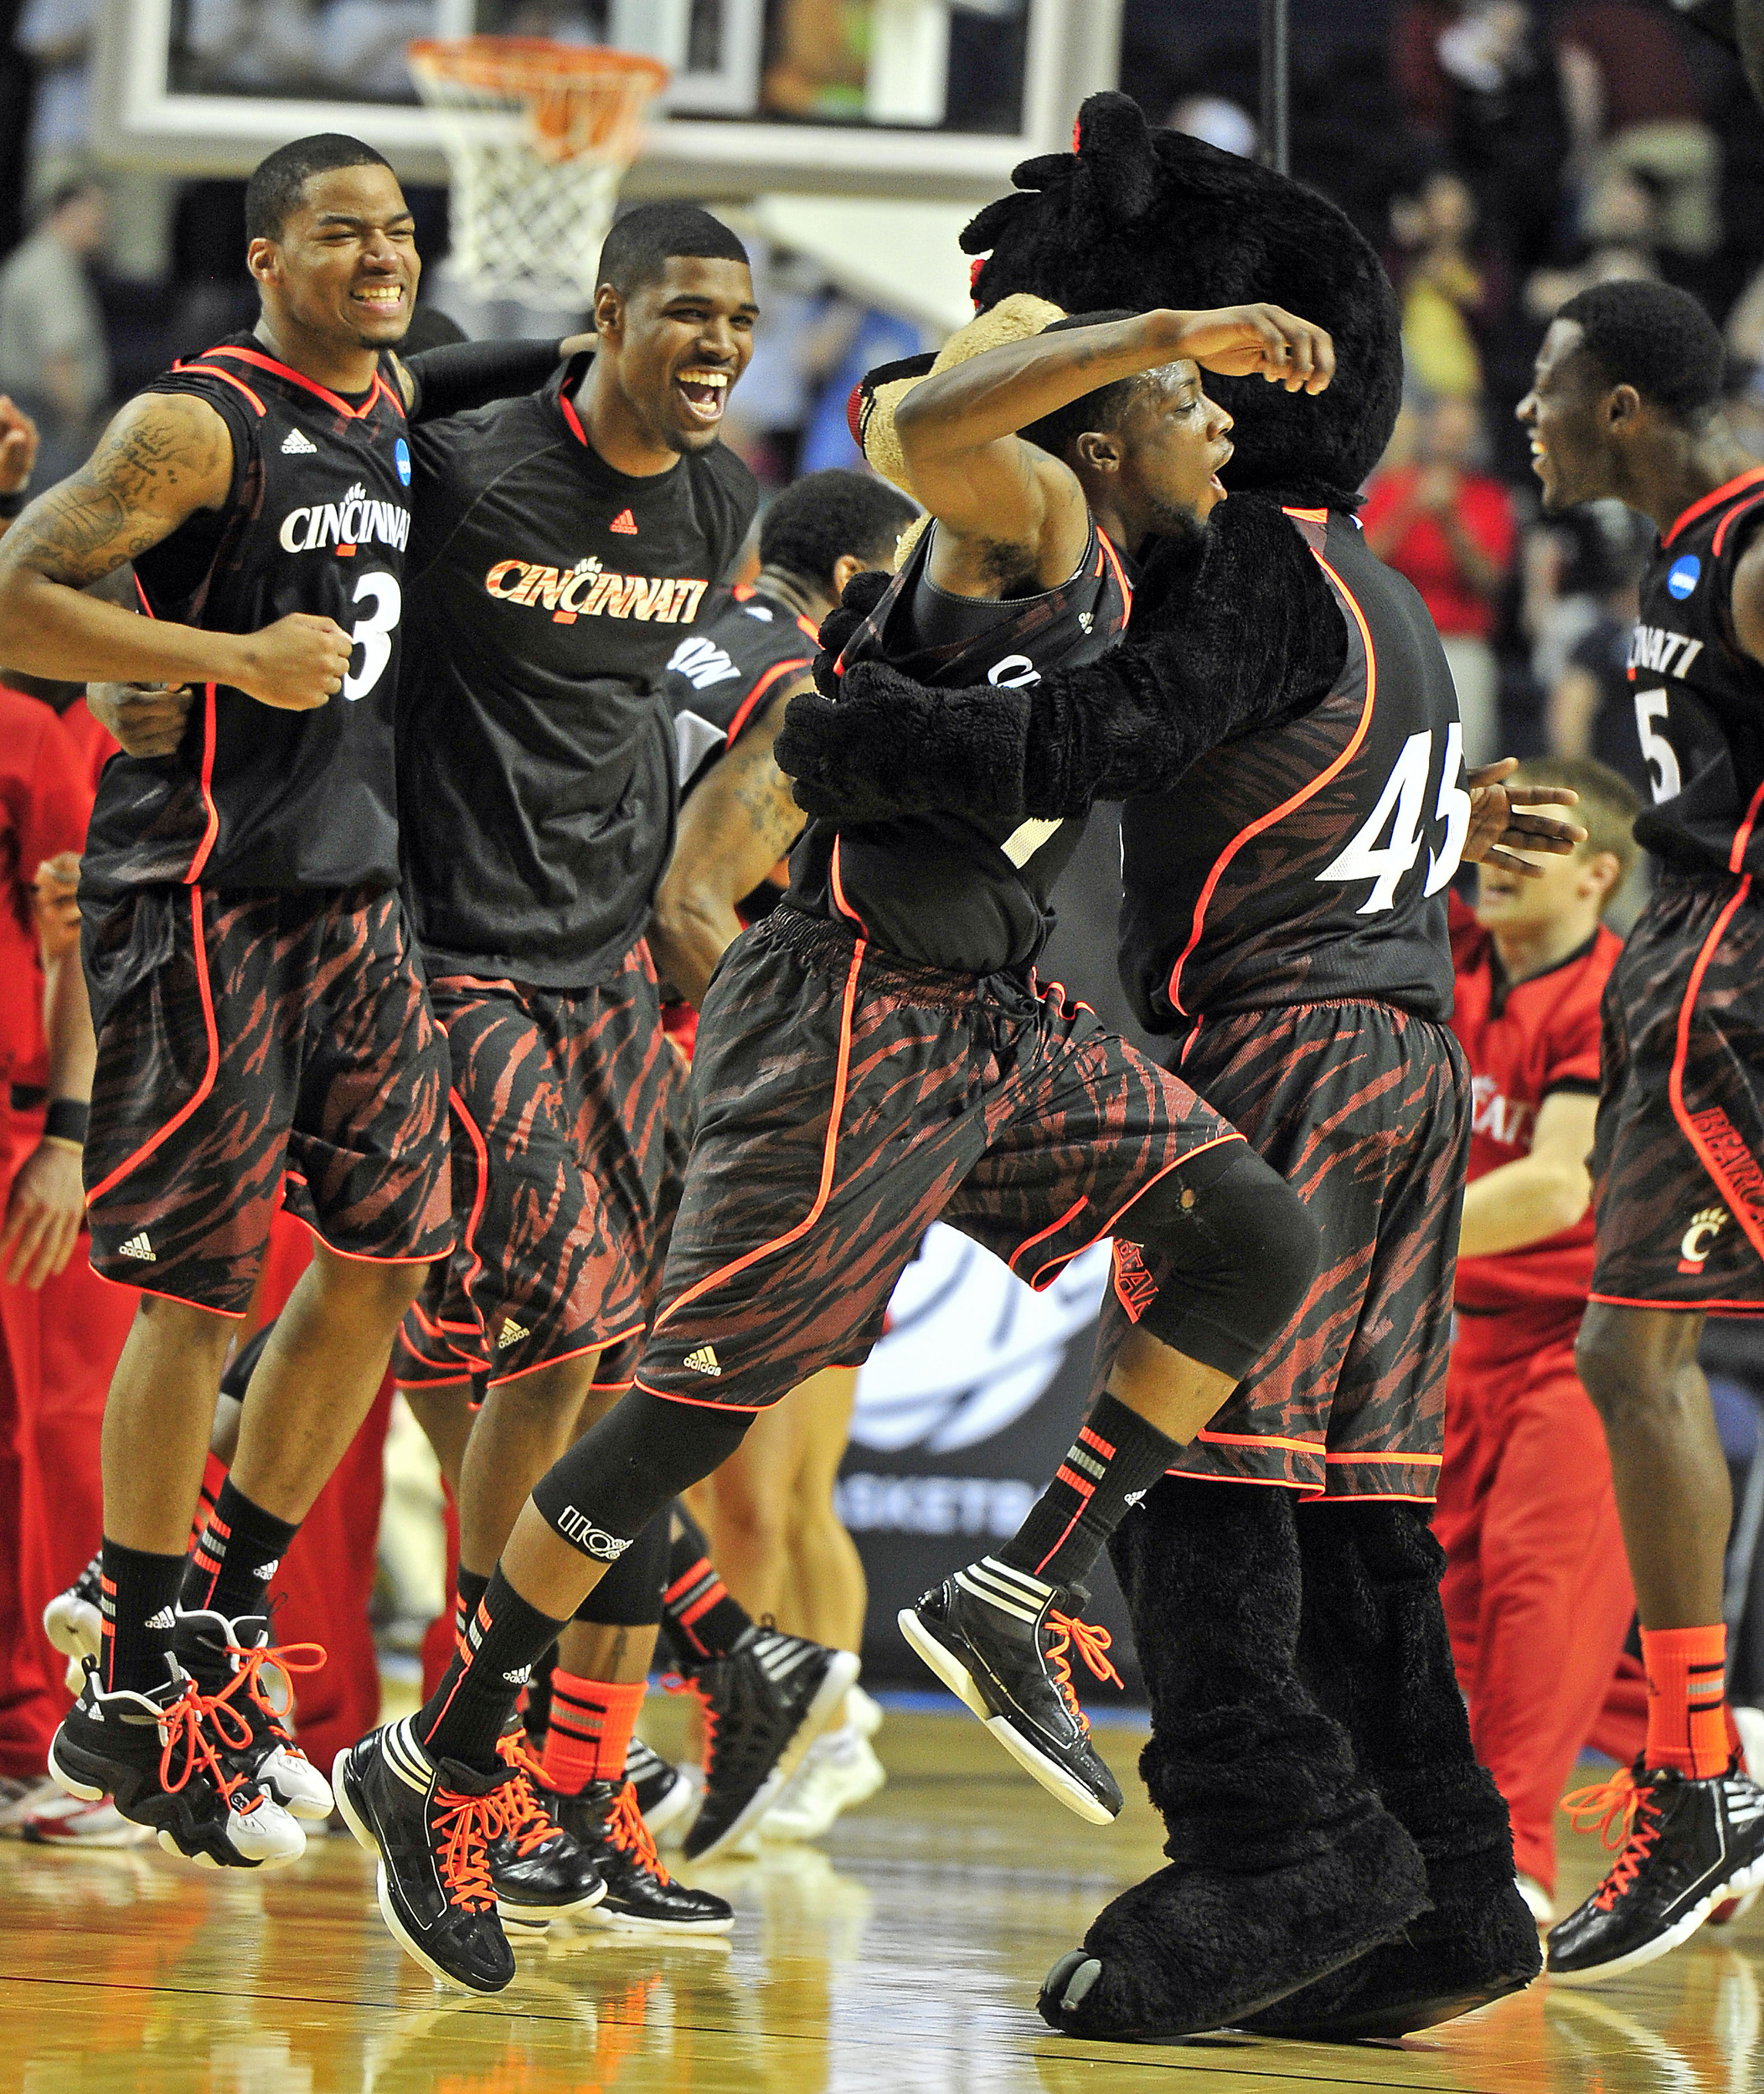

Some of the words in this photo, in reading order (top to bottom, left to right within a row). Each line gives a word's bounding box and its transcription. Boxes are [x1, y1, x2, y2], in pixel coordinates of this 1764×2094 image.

[485, 559, 709, 624] CINCINNATI
[343, 571, 401, 702] 3
[1634, 688, 1681, 806] 5
[1314, 721, 1473, 915] 45
[119, 1245, 157, 1262] adidas
[498, 1327, 531, 1349] adidas
[683, 1356, 722, 1378] adidas
